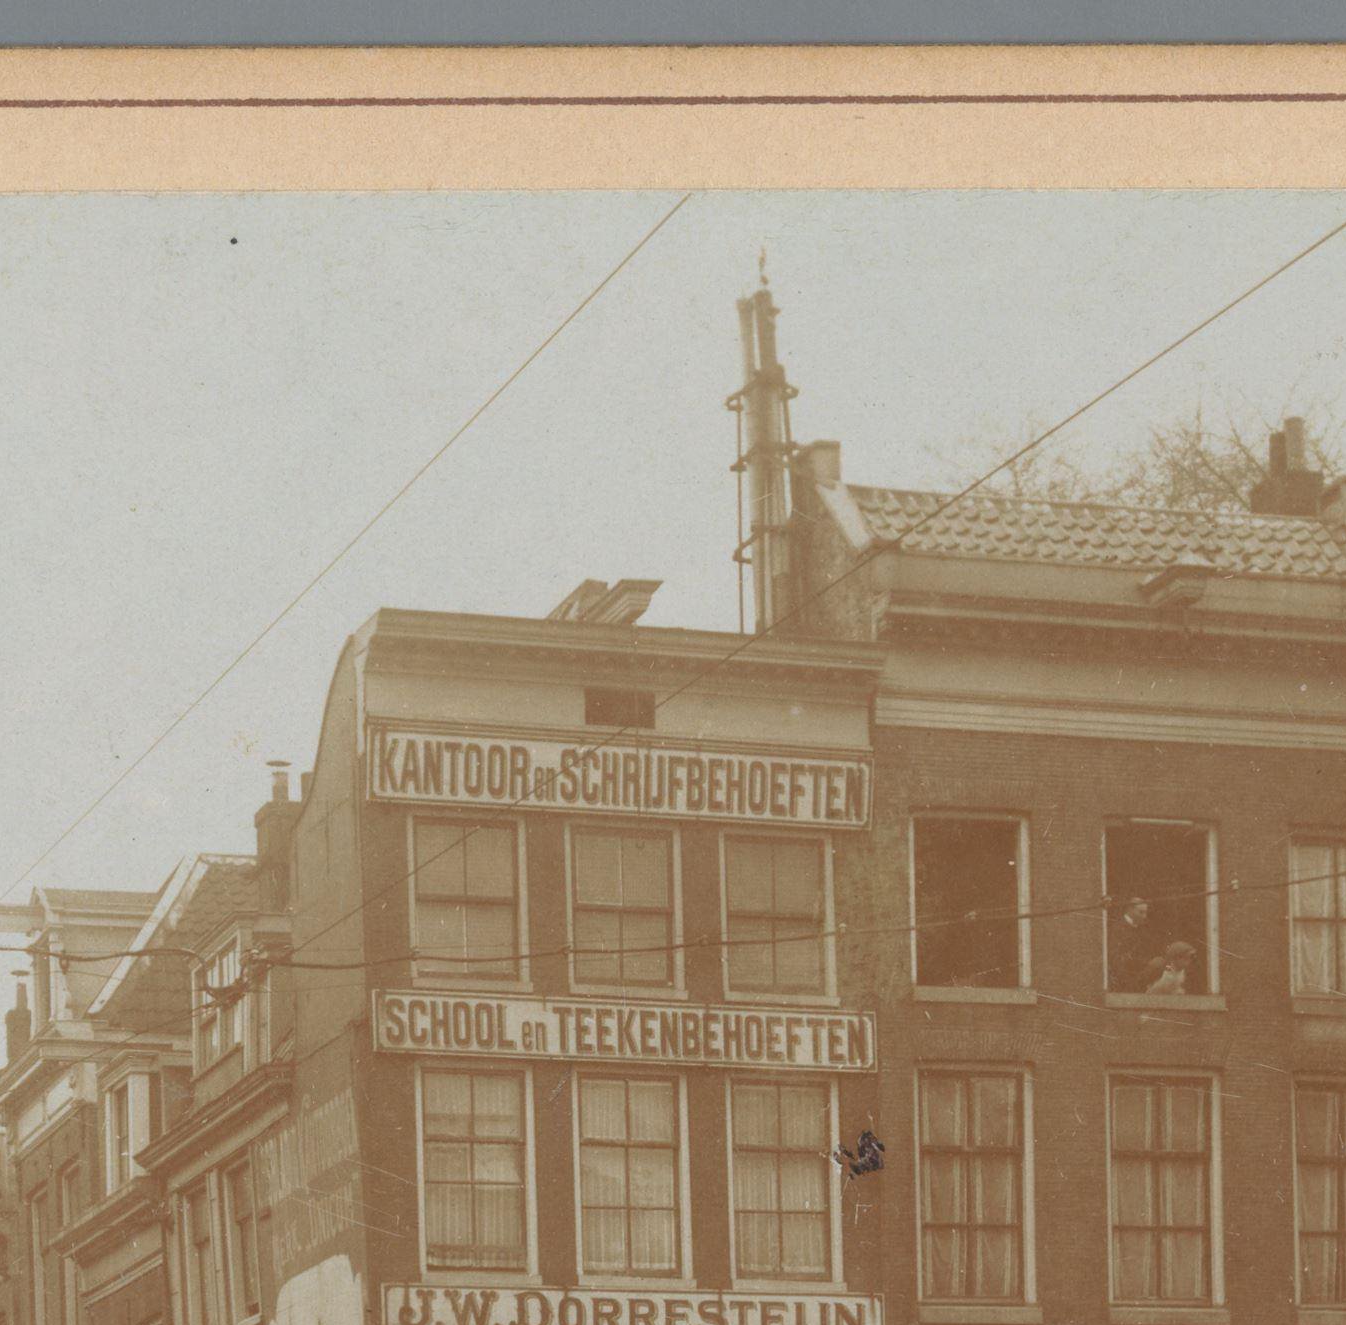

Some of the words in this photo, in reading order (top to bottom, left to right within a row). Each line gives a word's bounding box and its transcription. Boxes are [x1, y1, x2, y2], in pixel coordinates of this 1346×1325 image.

[378, 738, 528, 800] KANTOOR
[534, 765, 554, 801] en
[559, 748, 867, 822] SCHRIJFBEHOEFTEN
[384, 999, 514, 1051] SCHOOL
[521, 1019, 547, 1051] en
[558, 1007, 866, 1066] TEEKENBEHOEFTEN
